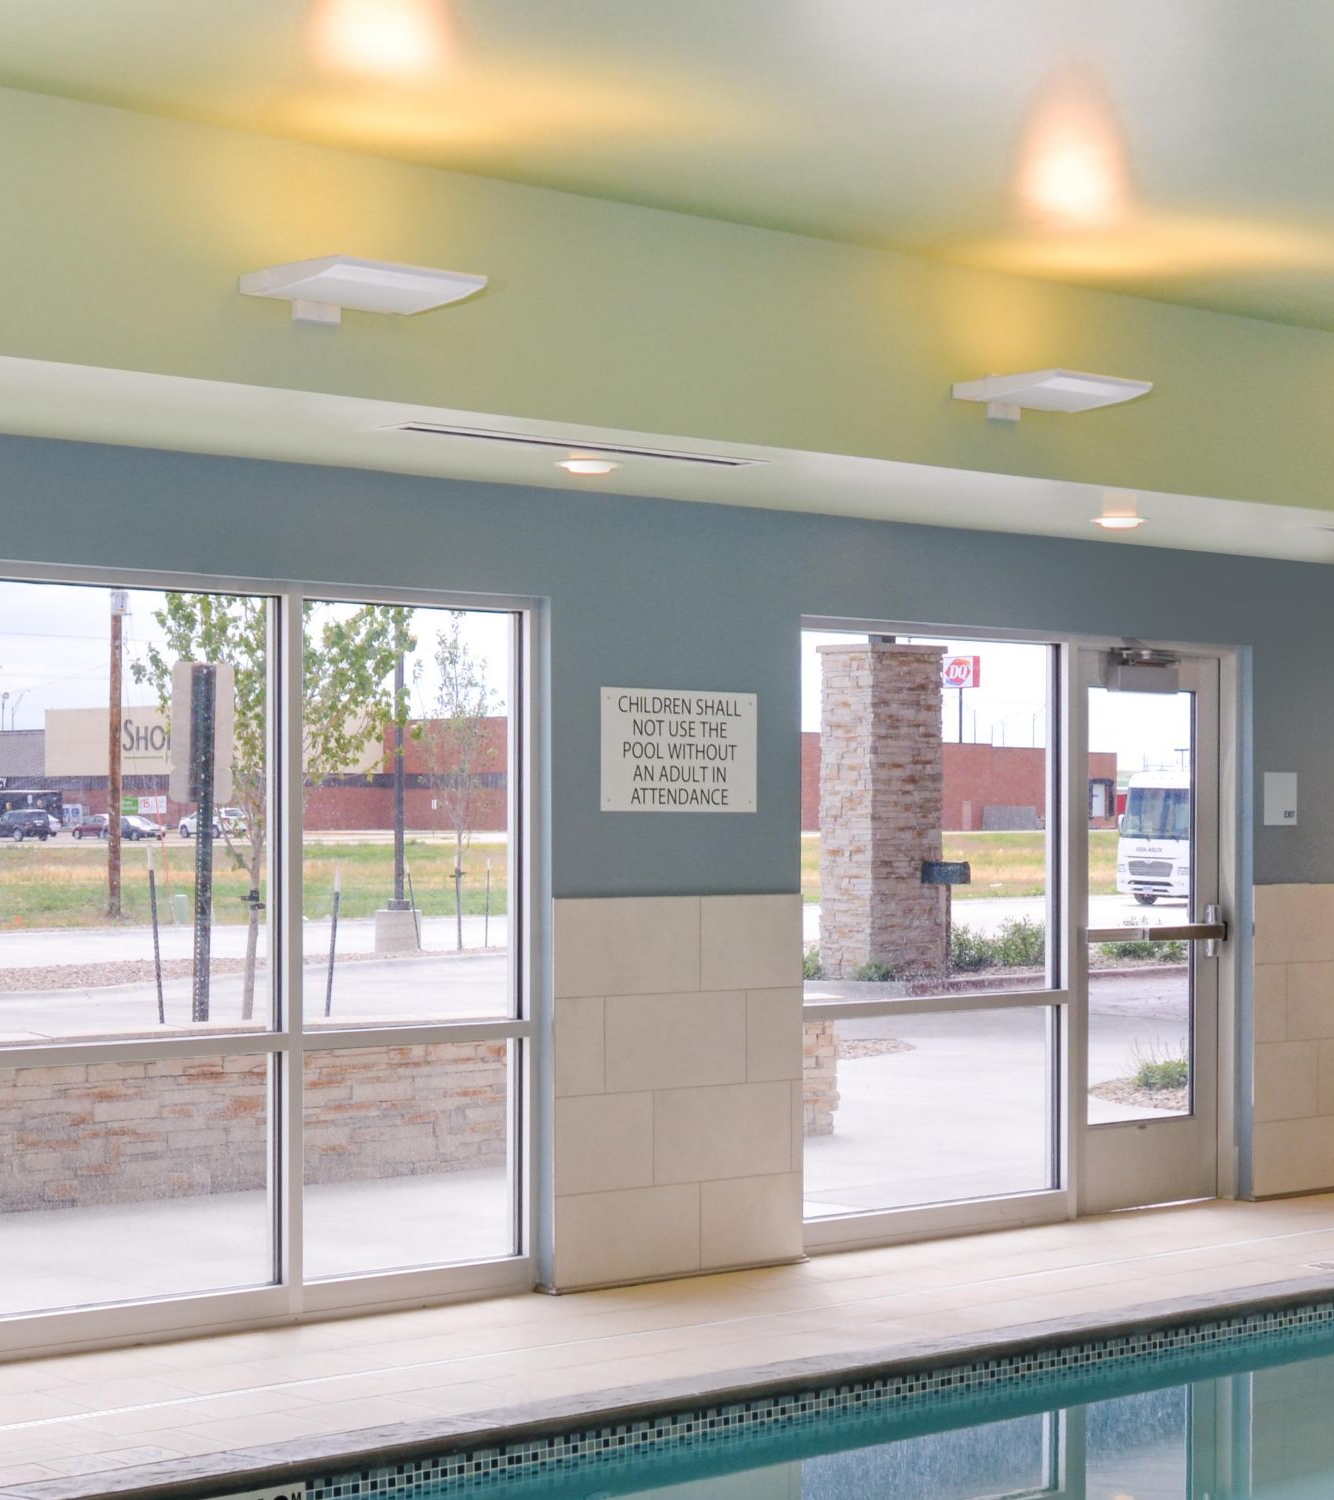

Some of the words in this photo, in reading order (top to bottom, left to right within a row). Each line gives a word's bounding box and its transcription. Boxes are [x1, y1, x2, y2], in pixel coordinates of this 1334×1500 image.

[950, 664, 968, 680] DQ
[618, 695, 692, 715] CHILDREN
[696, 699, 742, 717] SHALL
[633, 719, 665, 737] NOT
[669, 721, 696, 738] USE
[700, 721, 728, 738] THE
[623, 741, 664, 760] POOL
[668, 743, 737, 761] WITHOUT
[633, 765, 654, 782] AN
[659, 765, 708, 783] ADULT
[712, 766, 726, 783] IN
[631, 787, 729, 806] ATTENDANCE
